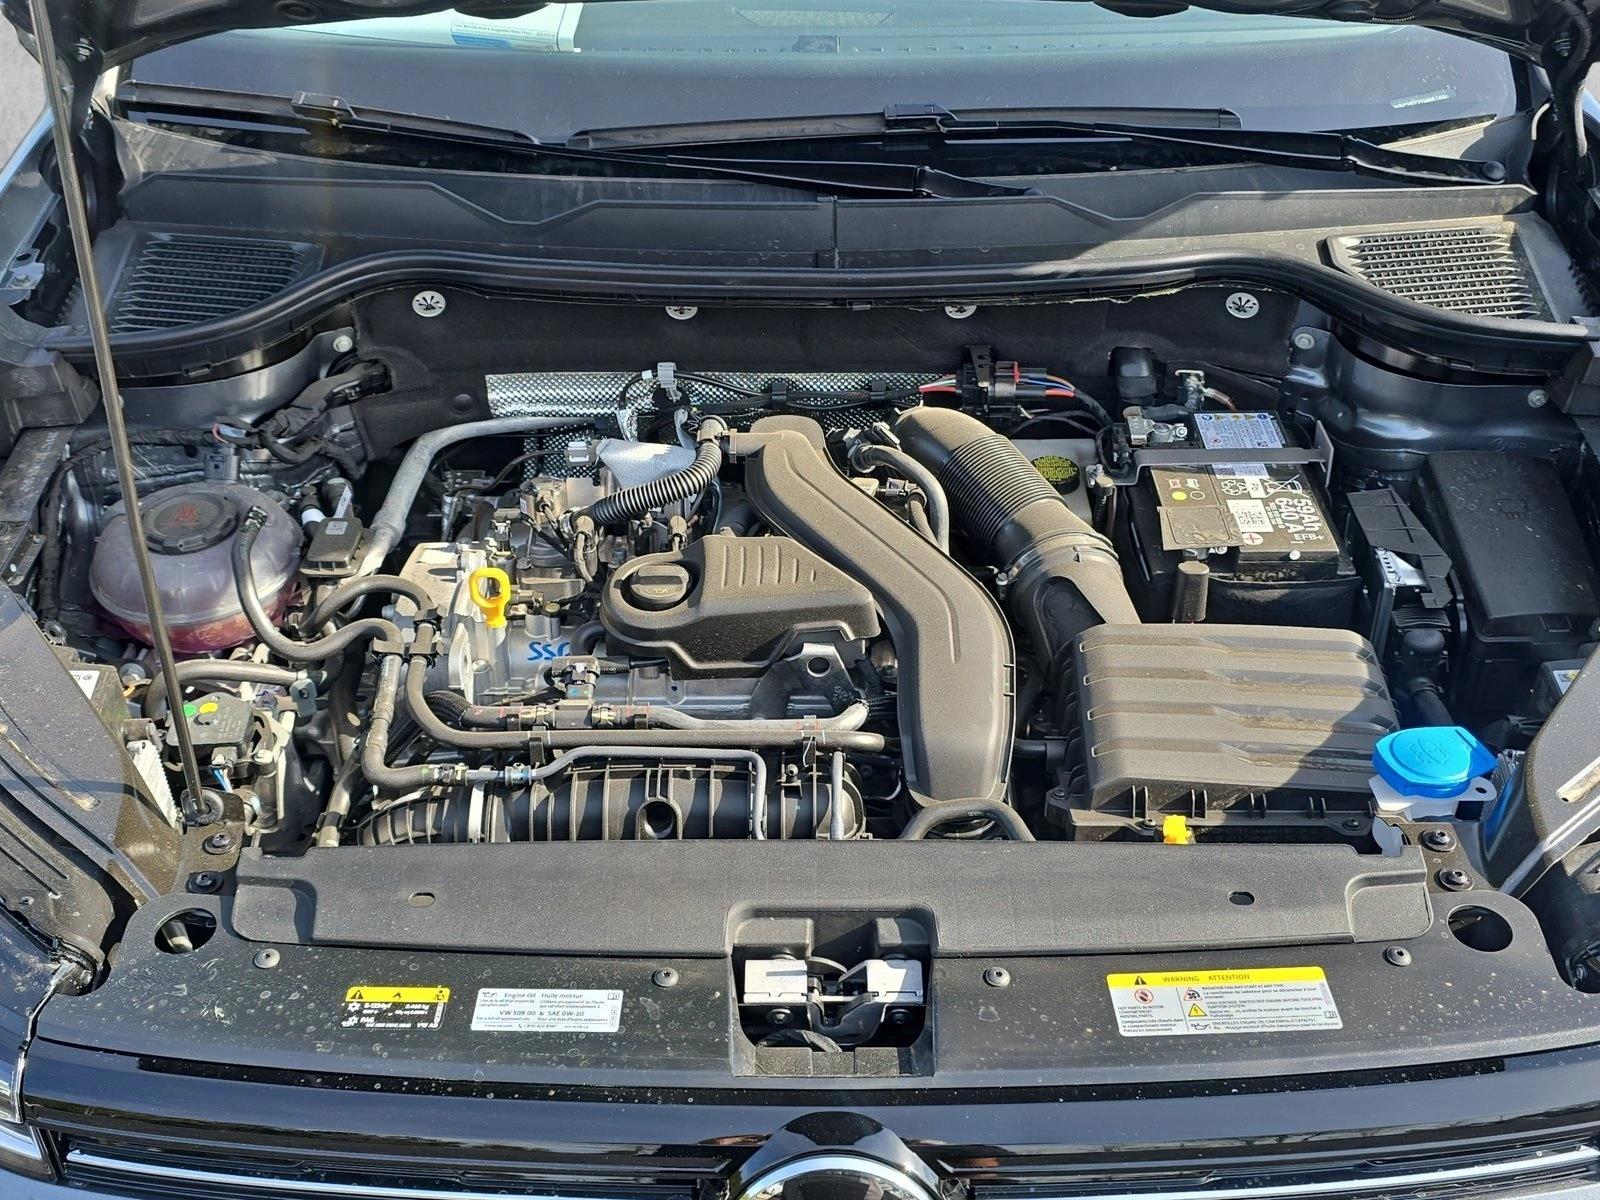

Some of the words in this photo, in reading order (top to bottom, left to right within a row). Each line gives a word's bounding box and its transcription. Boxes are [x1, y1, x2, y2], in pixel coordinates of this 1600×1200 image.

[1274, 497, 1300, 521] 640
[1293, 498, 1322, 532] 59Ah
[1293, 533, 1325, 541] EFB+
[1161, 975, 1200, 983] WARNING
[1208, 973, 1251, 981] ATTENTION
